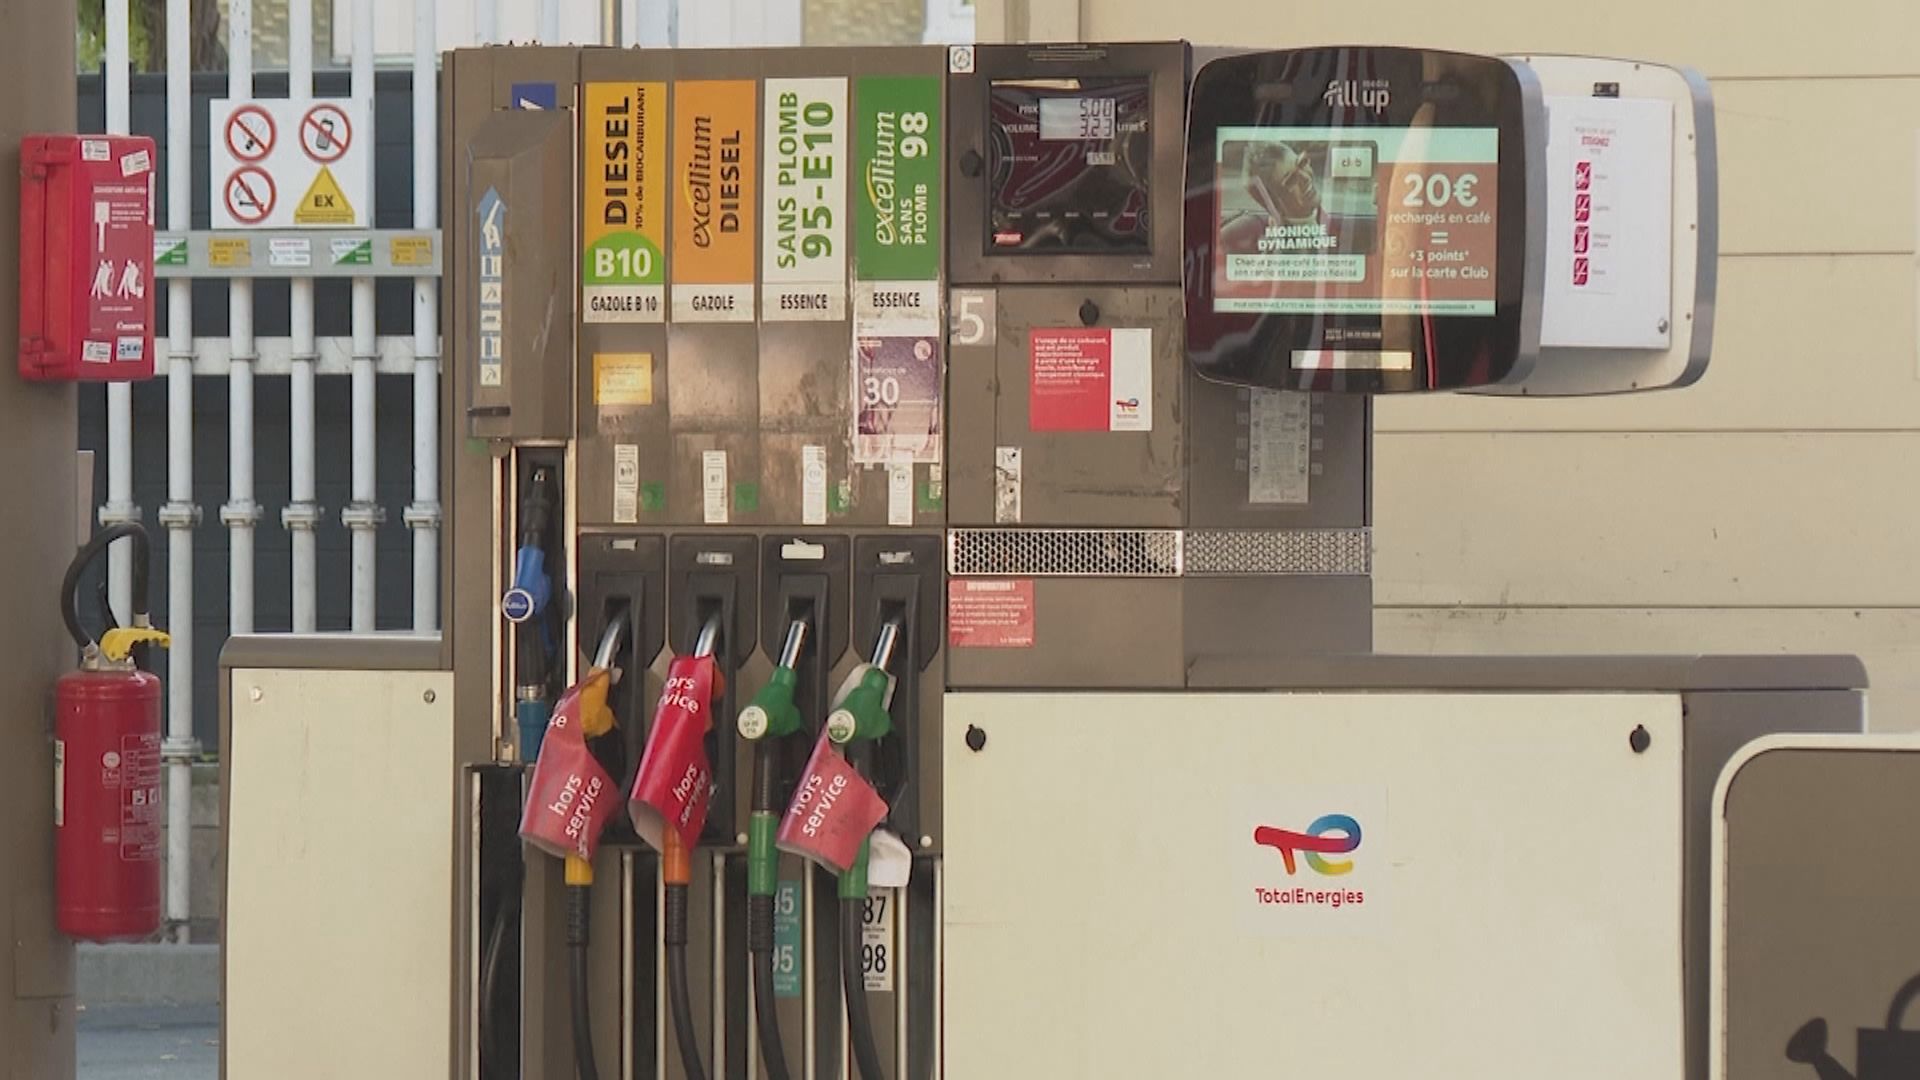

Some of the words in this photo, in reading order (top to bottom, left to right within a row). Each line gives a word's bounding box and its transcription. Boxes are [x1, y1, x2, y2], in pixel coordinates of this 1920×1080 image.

[1363, 90, 1390, 114] up
[636, 87, 645, 183] BIOCARBURANT
[778, 92, 798, 186] PLOMB
[900, 111, 929, 159] 98
[604, 96, 629, 225] DIESEL
[871, 111, 896, 246] excellium
[688, 115, 712, 248] excellium
[720, 130, 740, 233] DIESEL
[802, 102, 834, 259] 95-E10
[1402, 173, 1478, 207] 20€
[314, 194, 334, 208] EX
[915, 183, 928, 244] PLOMB
[1389, 211, 1446, 225] rechargés
[1448, 215, 1463, 223] en
[1466, 210, 1491, 223] café
[777, 197, 797, 268] SANS
[900, 198, 913, 245] SANS
[1265, 224, 1327, 238] MONIQUE
[1257, 236, 1338, 251] DYNAMIQUE
[1409, 250, 1424, 261] +3
[595, 248, 651, 278] B10
[1391, 268, 1408, 278] sur
[1412, 266, 1424, 278] la
[1427, 267, 1458, 278] carte
[1461, 266, 1489, 278] Club
[591, 296, 632, 312] GAZOLE
[635, 297, 641, 312] B
[645, 297, 657, 312] 10
[692, 295, 734, 312] GAZOLE
[780, 294, 828, 309] ESSENCE
[872, 292, 920, 307] ESSENCE
[960, 295, 985, 345] 5
[863, 376, 899, 405] 30
[666, 676, 695, 690] ors
[548, 774, 582, 816] hors
[672, 762, 698, 803] hors
[680, 769, 706, 828] service
[790, 773, 823, 816] hors
[565, 775, 603, 839] service
[802, 774, 848, 837] service
[862, 896, 887, 925] 87
[1255, 887, 1364, 908] TotalEnergies
[860, 943, 887, 974] 98
